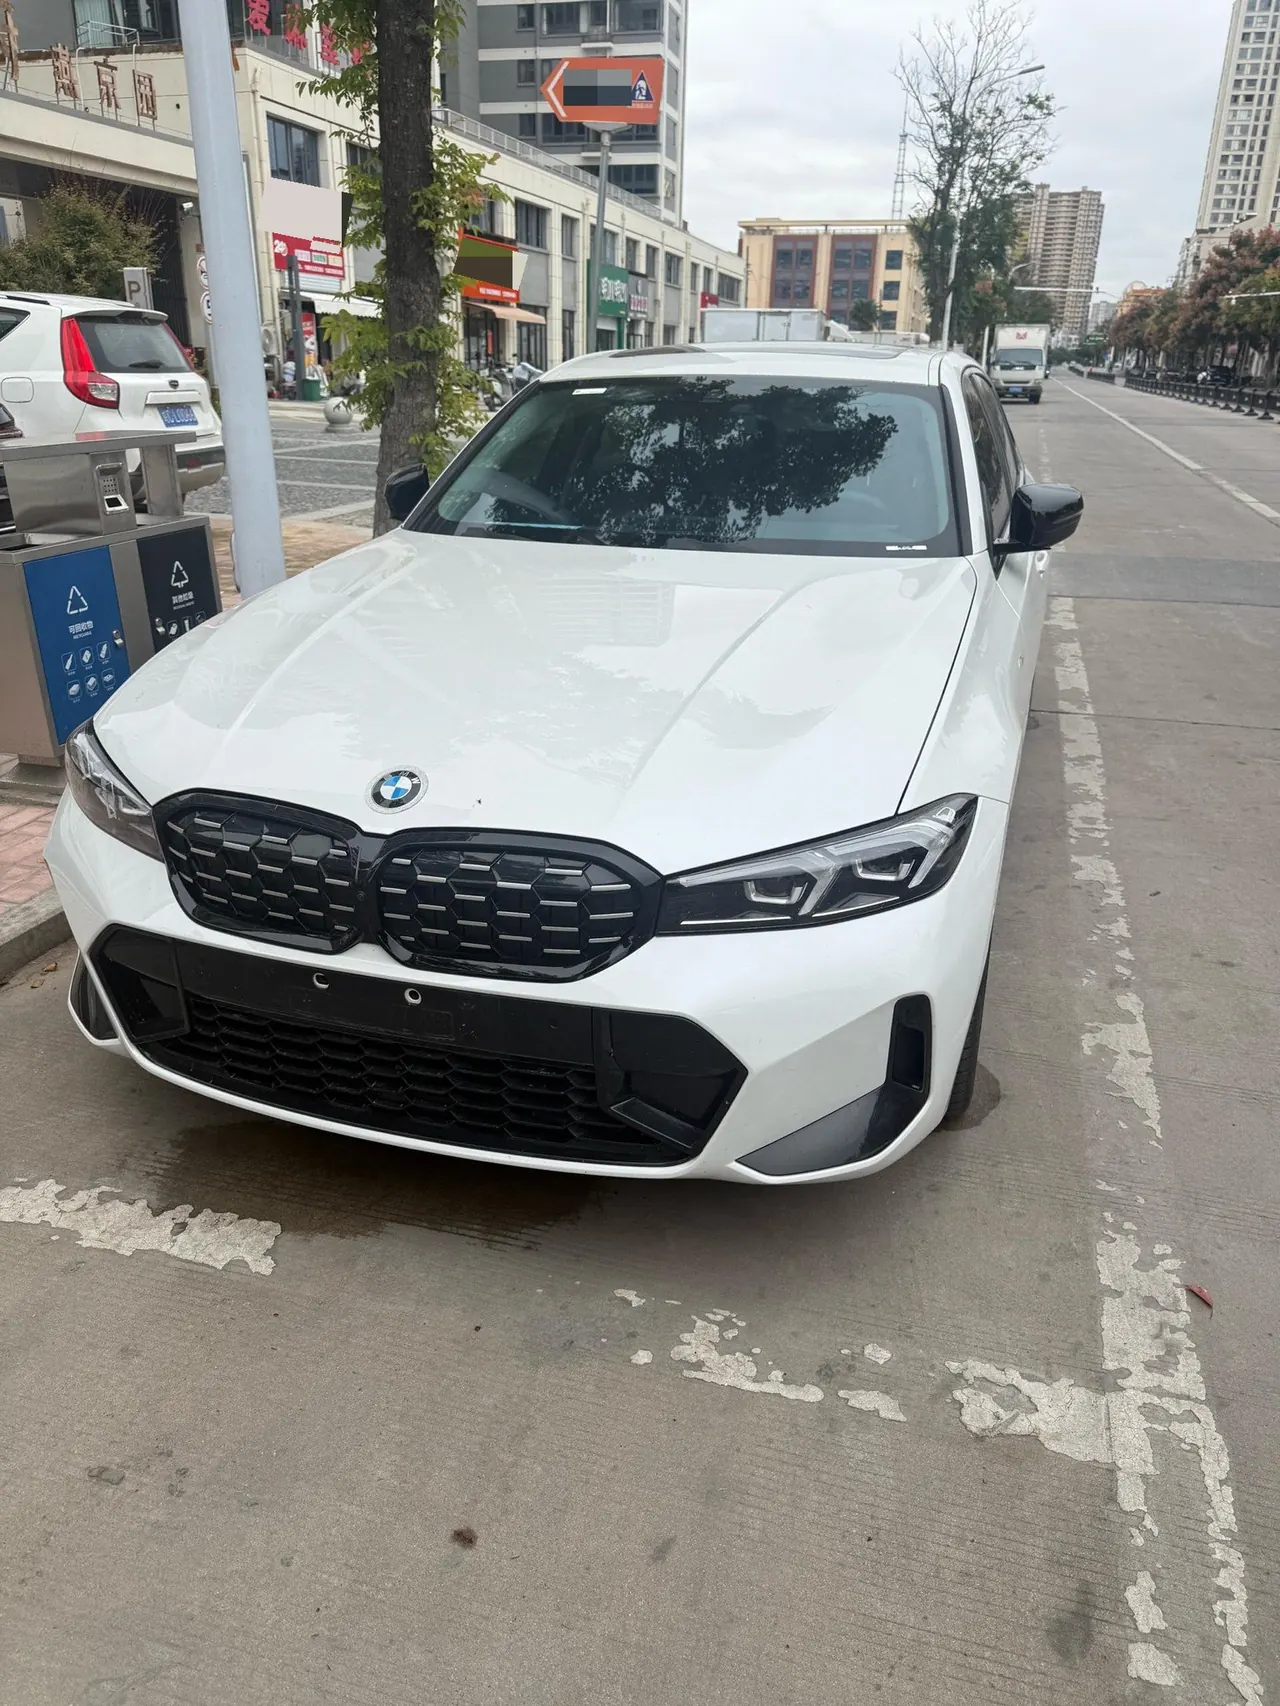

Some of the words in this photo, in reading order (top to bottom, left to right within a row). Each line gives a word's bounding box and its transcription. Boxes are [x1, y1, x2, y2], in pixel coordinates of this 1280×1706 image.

[127, 281, 141, 301] P
[68, 620, 94, 634] 可回收物
